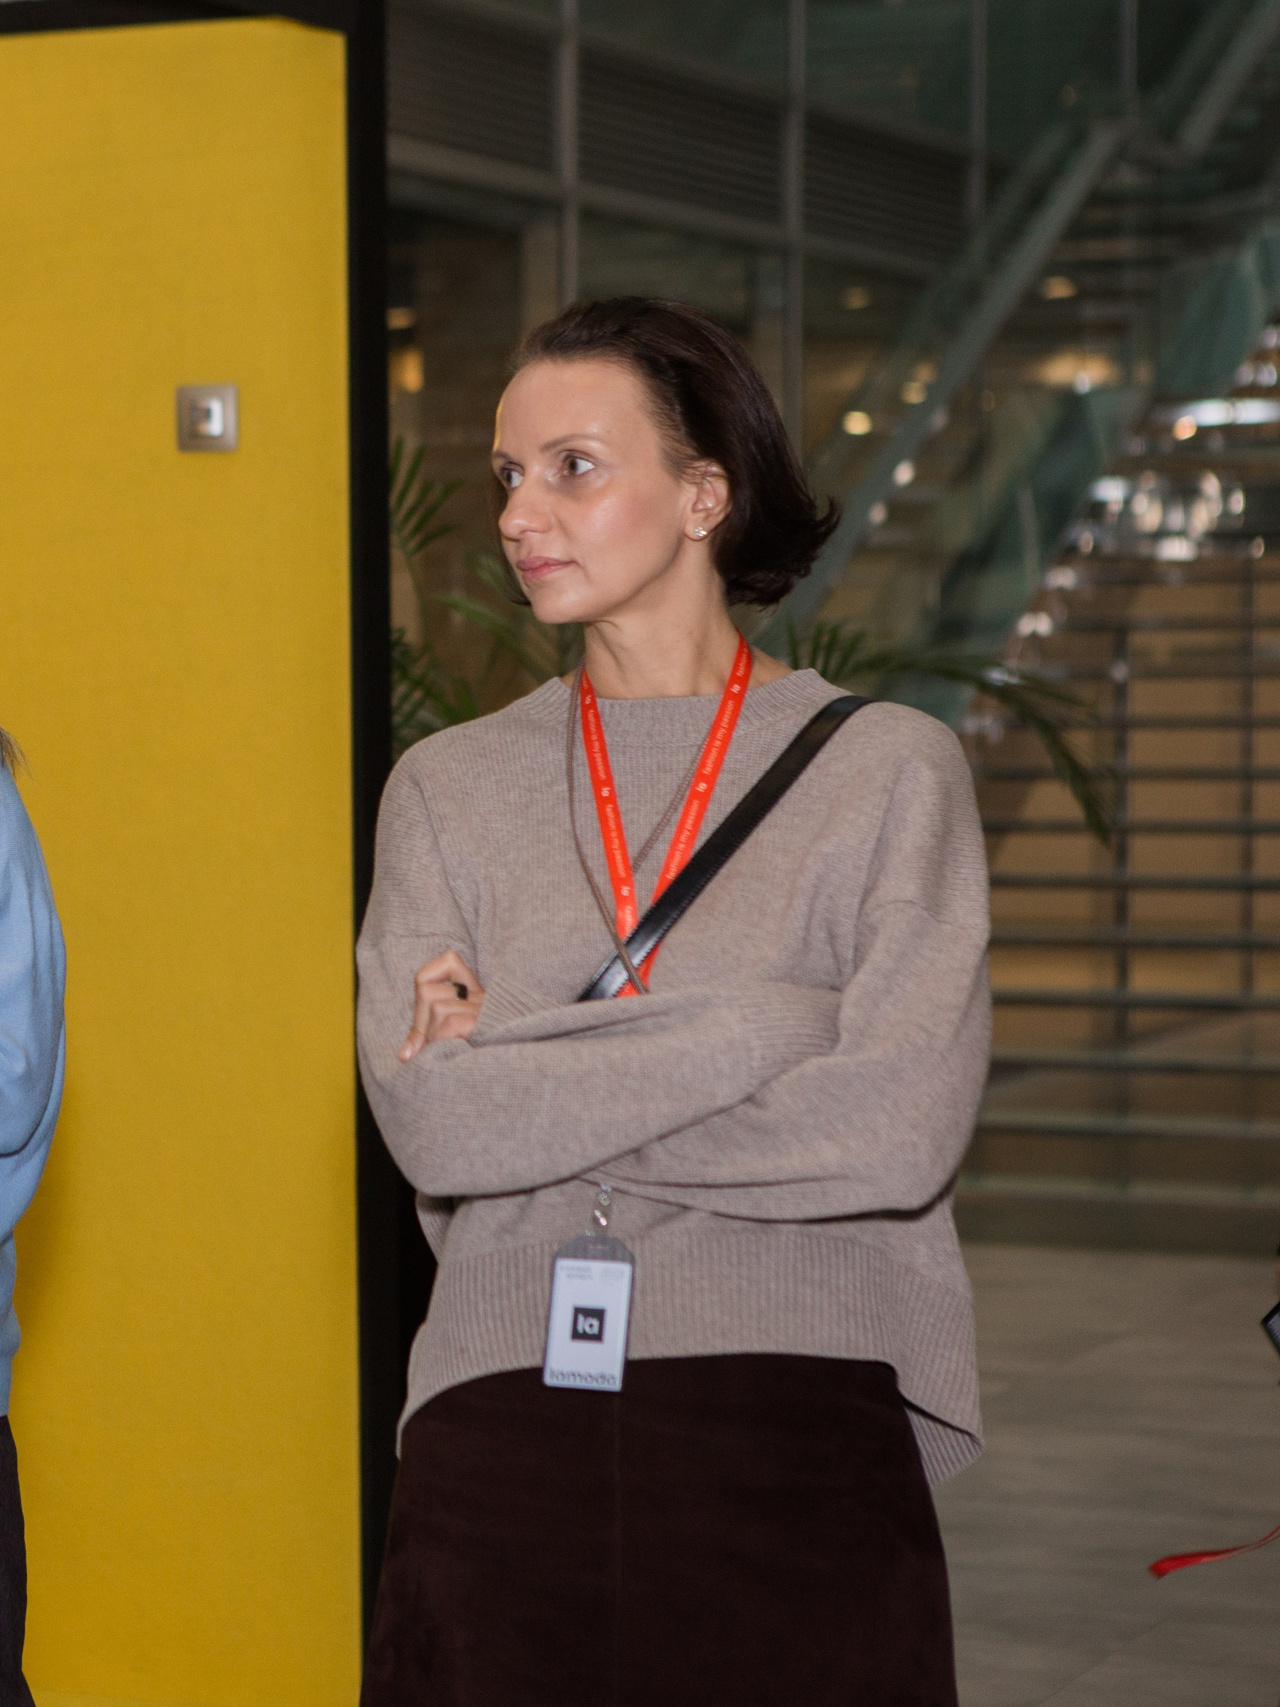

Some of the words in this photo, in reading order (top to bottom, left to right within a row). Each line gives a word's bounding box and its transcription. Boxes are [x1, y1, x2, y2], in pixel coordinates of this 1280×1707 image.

[721, 700, 734, 726] passion
[717, 725, 728, 739] my
[713, 739, 721, 748] is
[702, 748, 718, 775] fashion
[696, 782, 708, 793] la
[685, 800, 700, 830] passion
[611, 838, 620, 850] my
[680, 829, 691, 843] my
[677, 842, 685, 851] is
[613, 849, 626, 878] passion
[666, 851, 683, 880] fashion
[576, 1312, 600, 1335] la
[549, 1367, 618, 1387] lamoda
